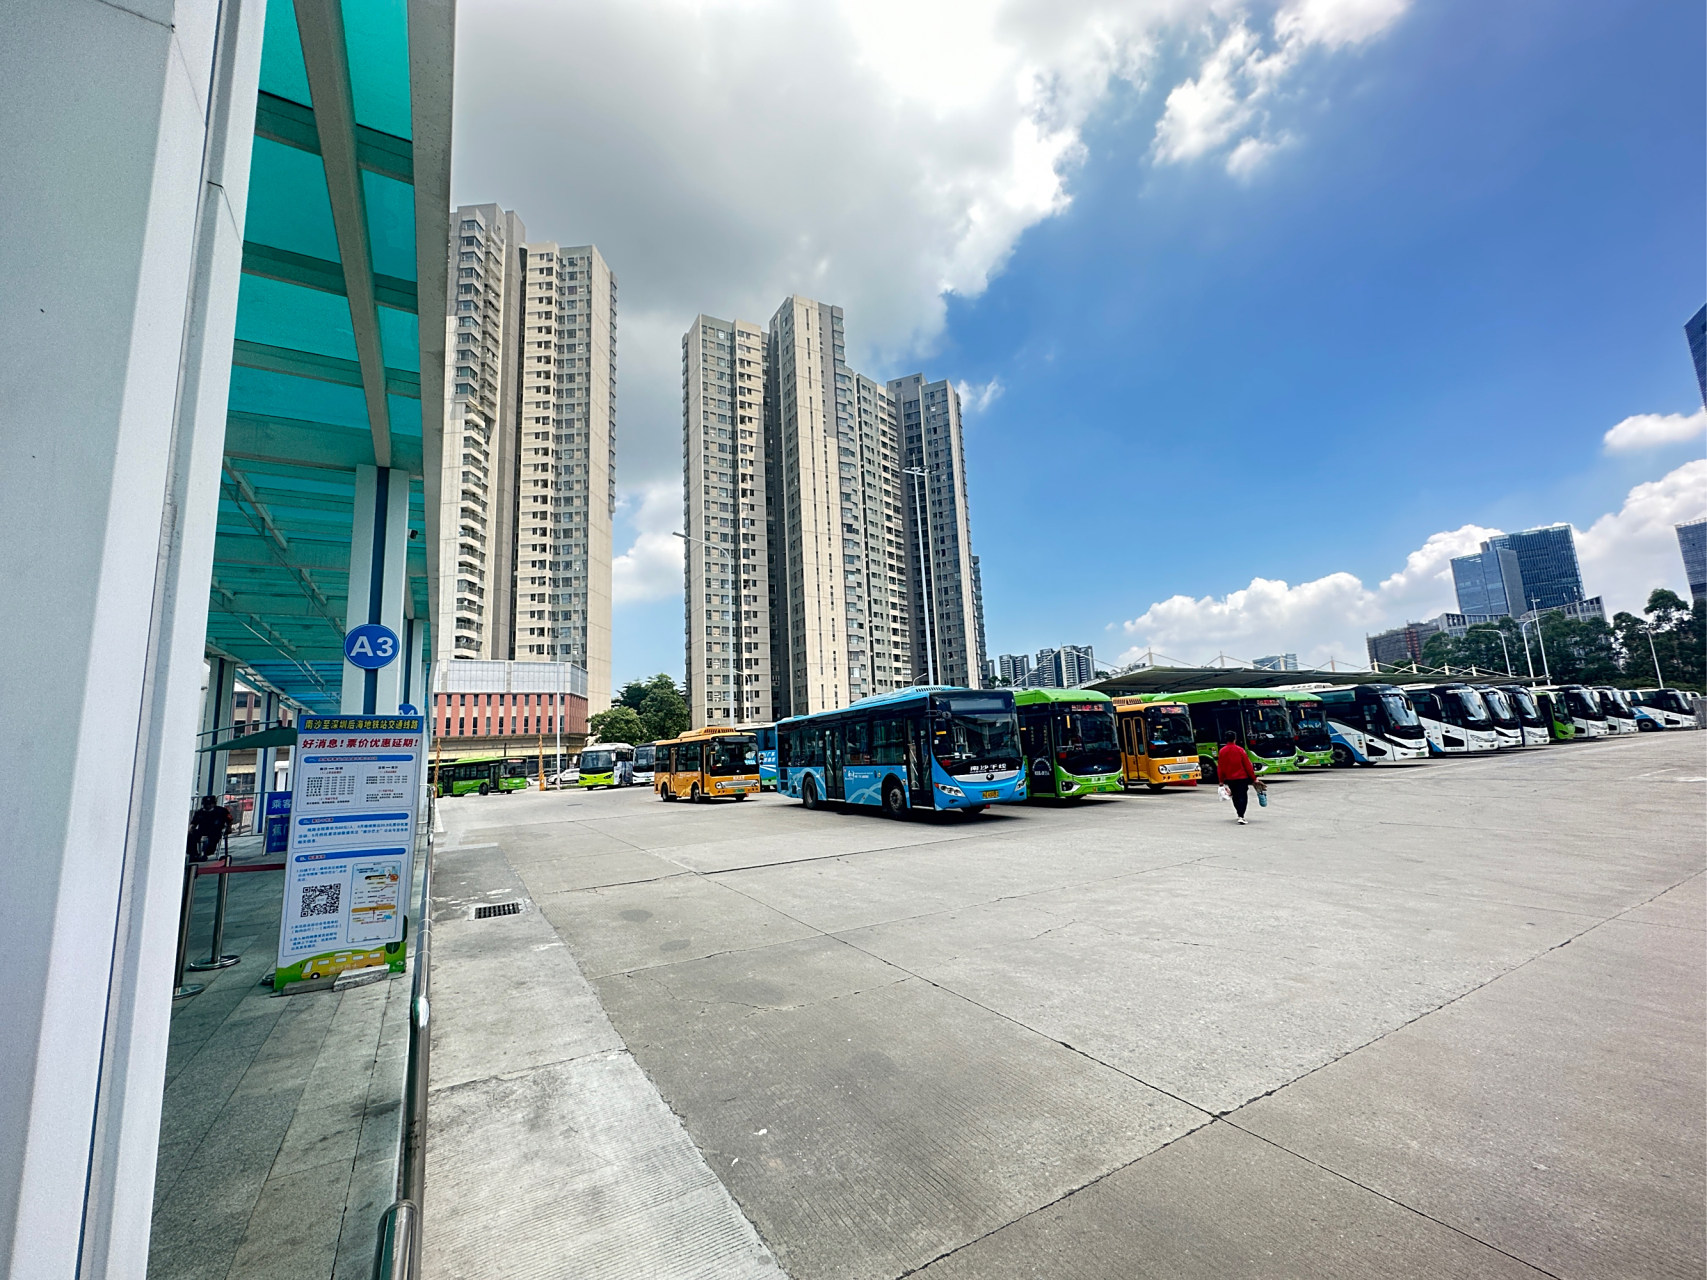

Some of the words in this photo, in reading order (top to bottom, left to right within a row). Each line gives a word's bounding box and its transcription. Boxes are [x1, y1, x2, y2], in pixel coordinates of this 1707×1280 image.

[350, 636, 393, 656] A3
[305, 718, 418, 731] 南沙至深圳后海地铁站交通线路
[302, 738, 418, 749] 好消息!票价优惠延期!
